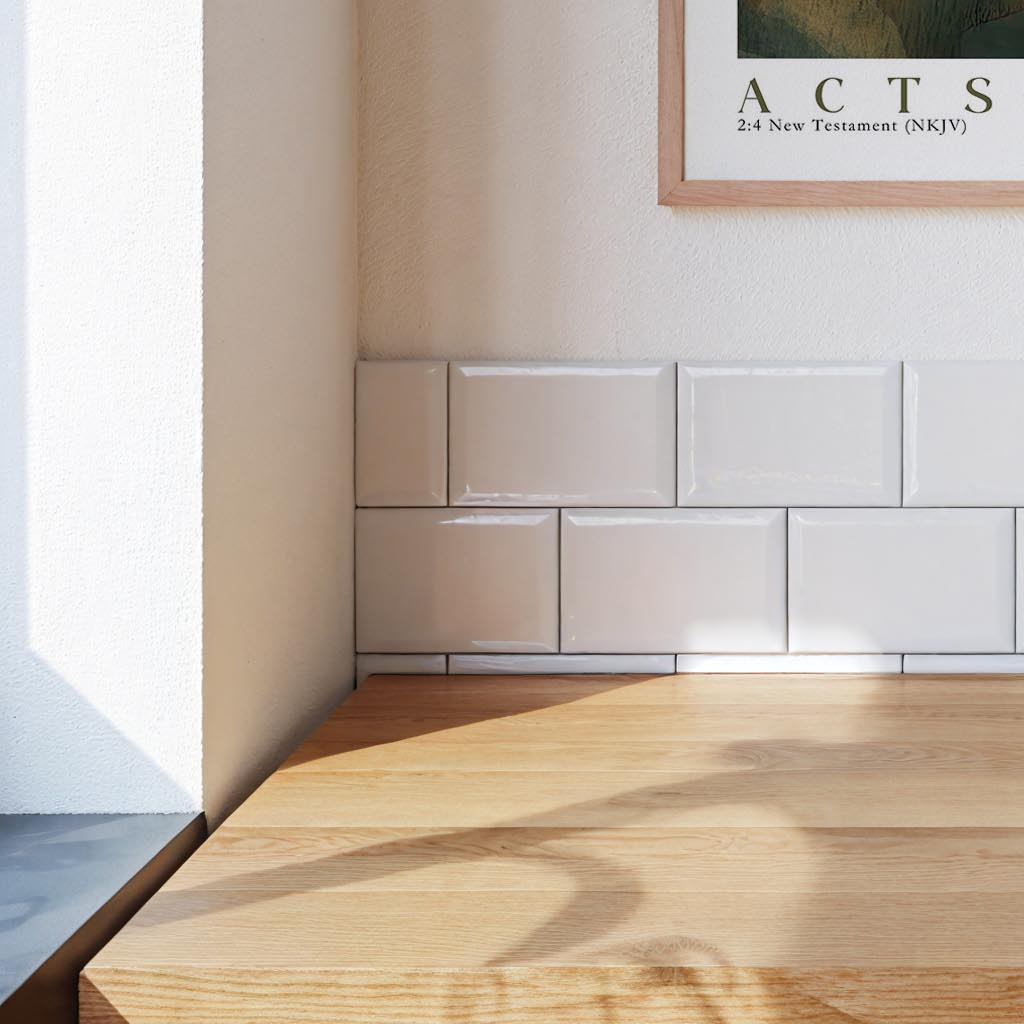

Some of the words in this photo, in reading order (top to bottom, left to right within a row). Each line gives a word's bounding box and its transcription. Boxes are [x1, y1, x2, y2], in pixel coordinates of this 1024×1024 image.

[738, 77, 993, 114] ACTS
[737, 119, 762, 132] 2:4
[769, 119, 806, 132] New
[812, 119, 898, 132] Testament
[905, 119, 967, 136] (NKJV)
